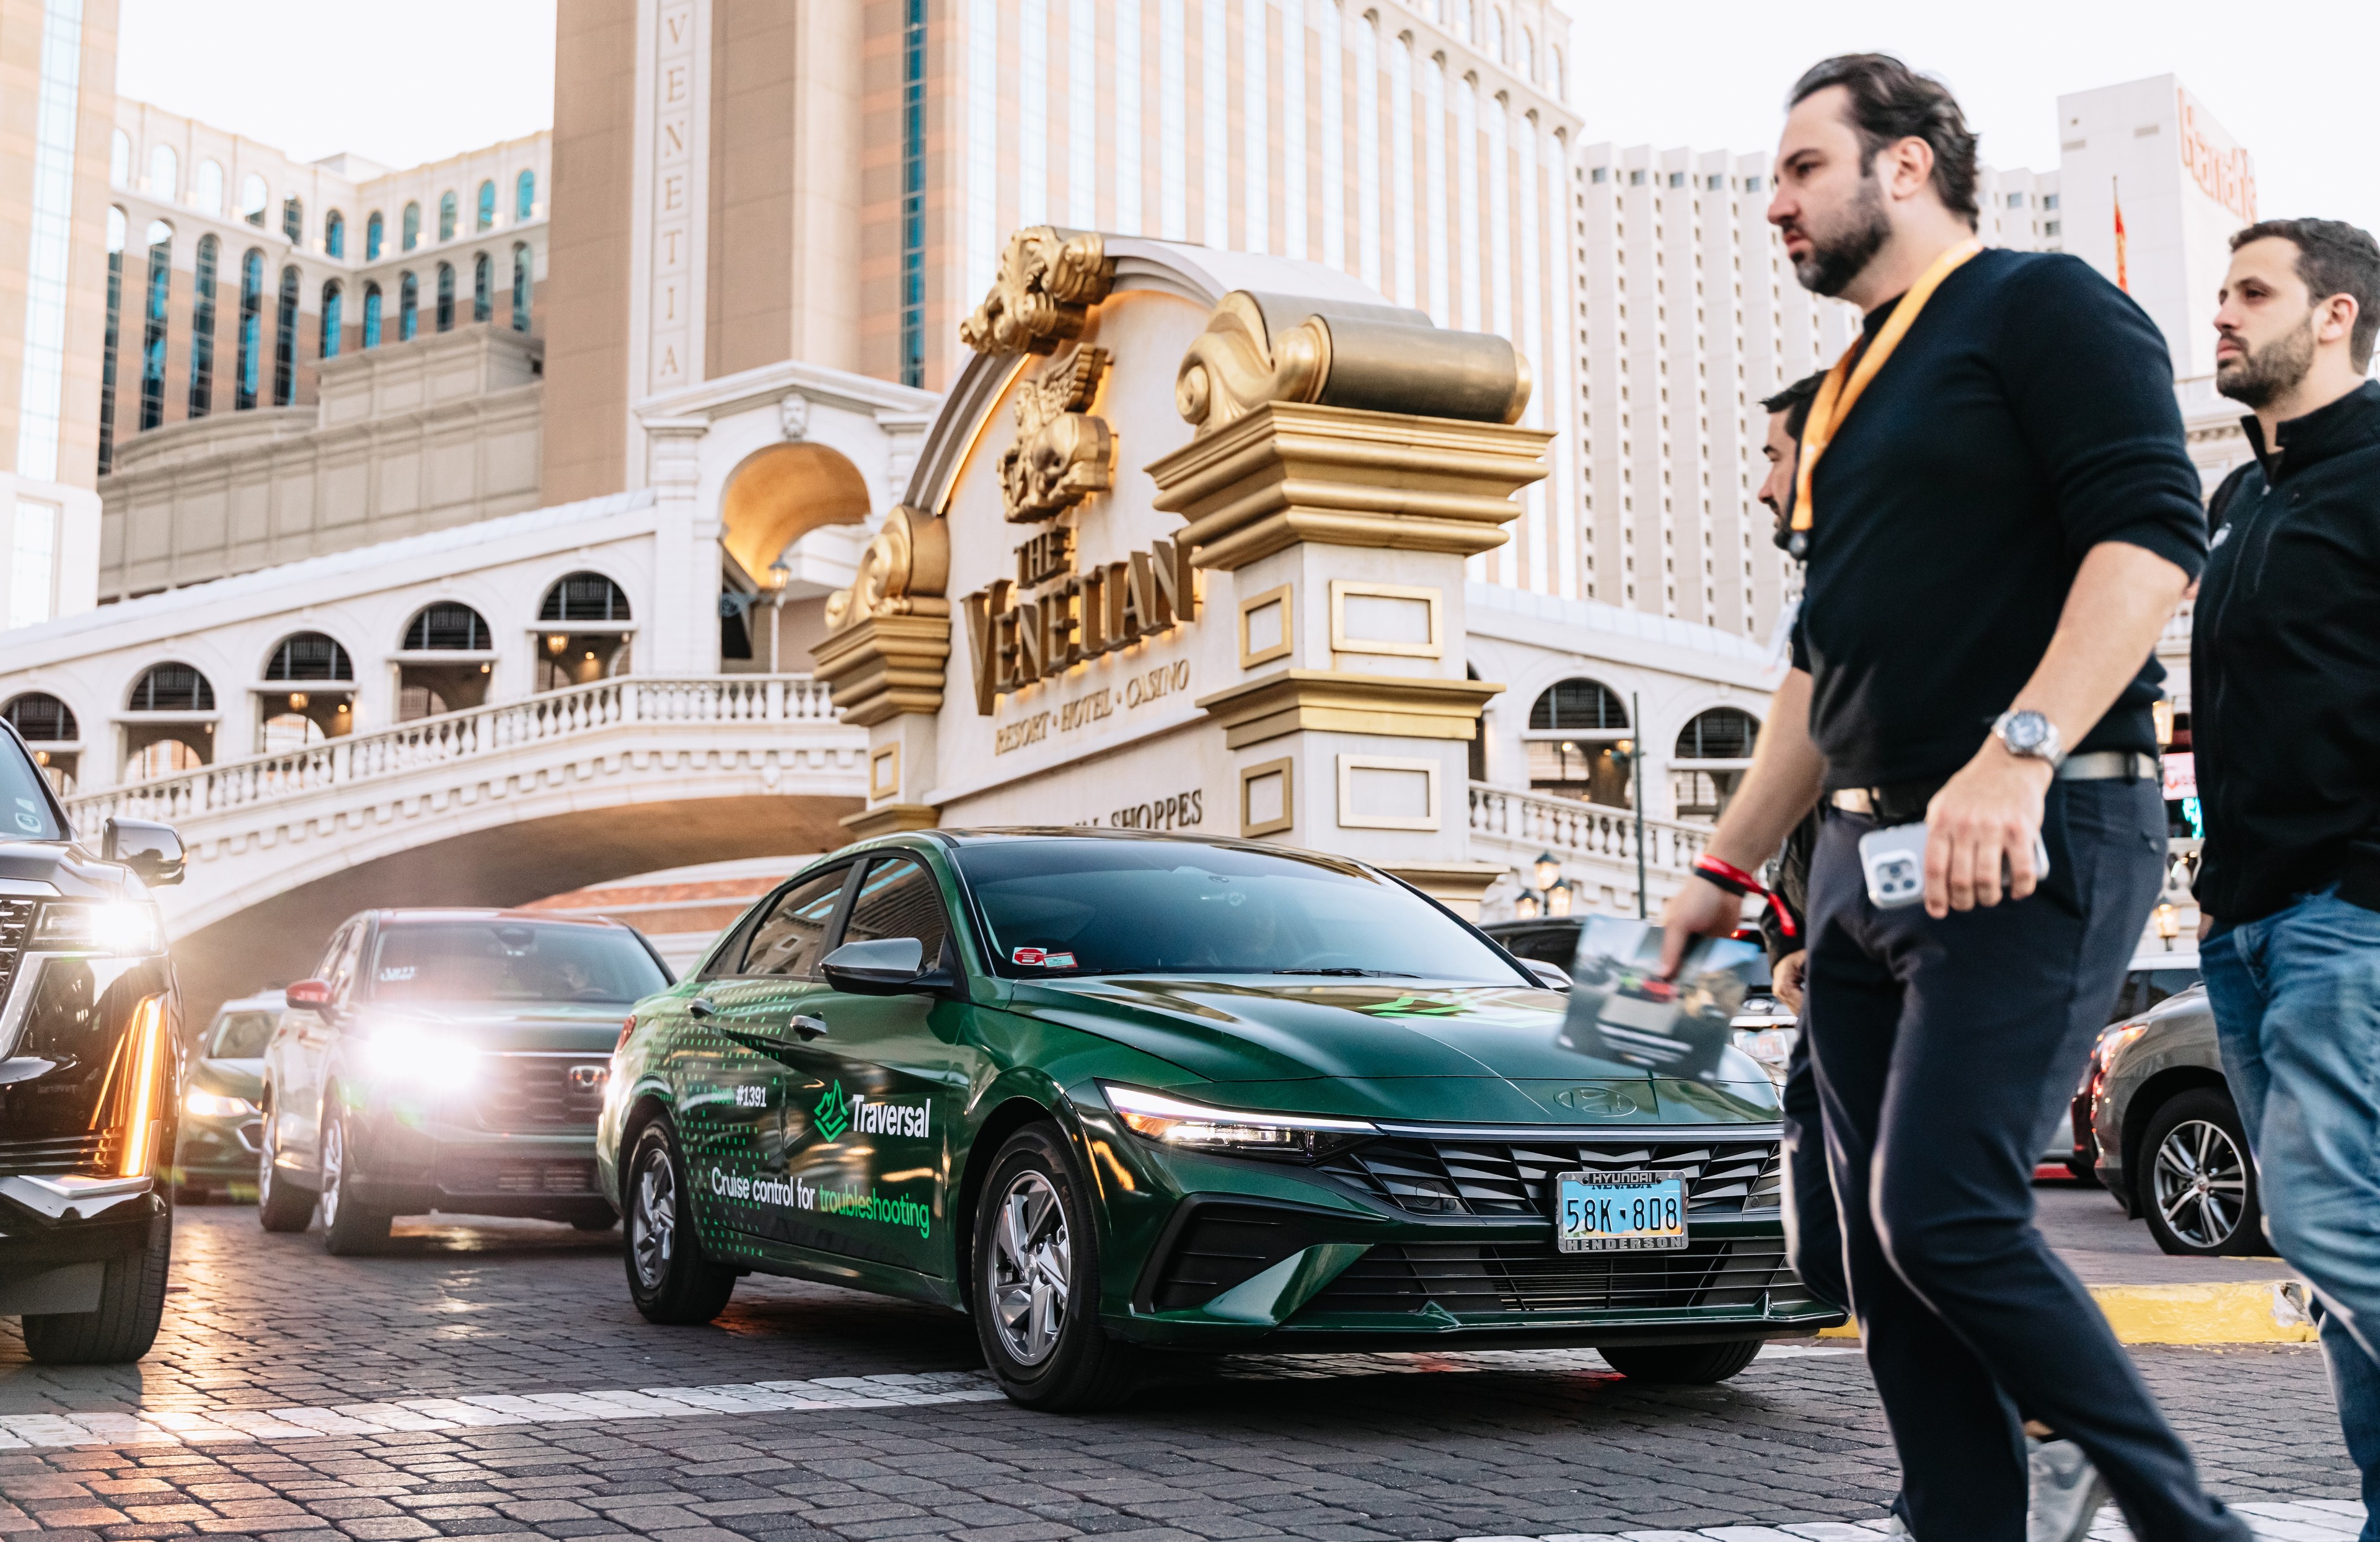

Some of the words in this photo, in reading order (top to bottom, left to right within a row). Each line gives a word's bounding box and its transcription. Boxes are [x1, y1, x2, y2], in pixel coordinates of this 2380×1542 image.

[659, 14, 686, 376] VENETIA
[1014, 526, 1072, 589] THE
[960, 529, 1195, 716] VENETIAN
[995, 711, 1051, 757] RESORT
[1060, 687, 1113, 732] HOTEL
[1126, 658, 1191, 709] CASINO
[1111, 788, 1203, 830] SHOPPES
[736, 1085, 767, 1108] #1391
[852, 1094, 931, 1138] Traversal
[1592, 1173, 1652, 1184] HYUNDAI
[712, 1166, 750, 1200] Cruise
[752, 1176, 795, 1207] control
[797, 1178, 816, 1210] for
[819, 1183, 930, 1239] troubleshooting
[1566, 1197, 1613, 1233] 58K
[1633, 1197, 1677, 1231] 808
[1566, 1237, 1682, 1251] HENDERSON
